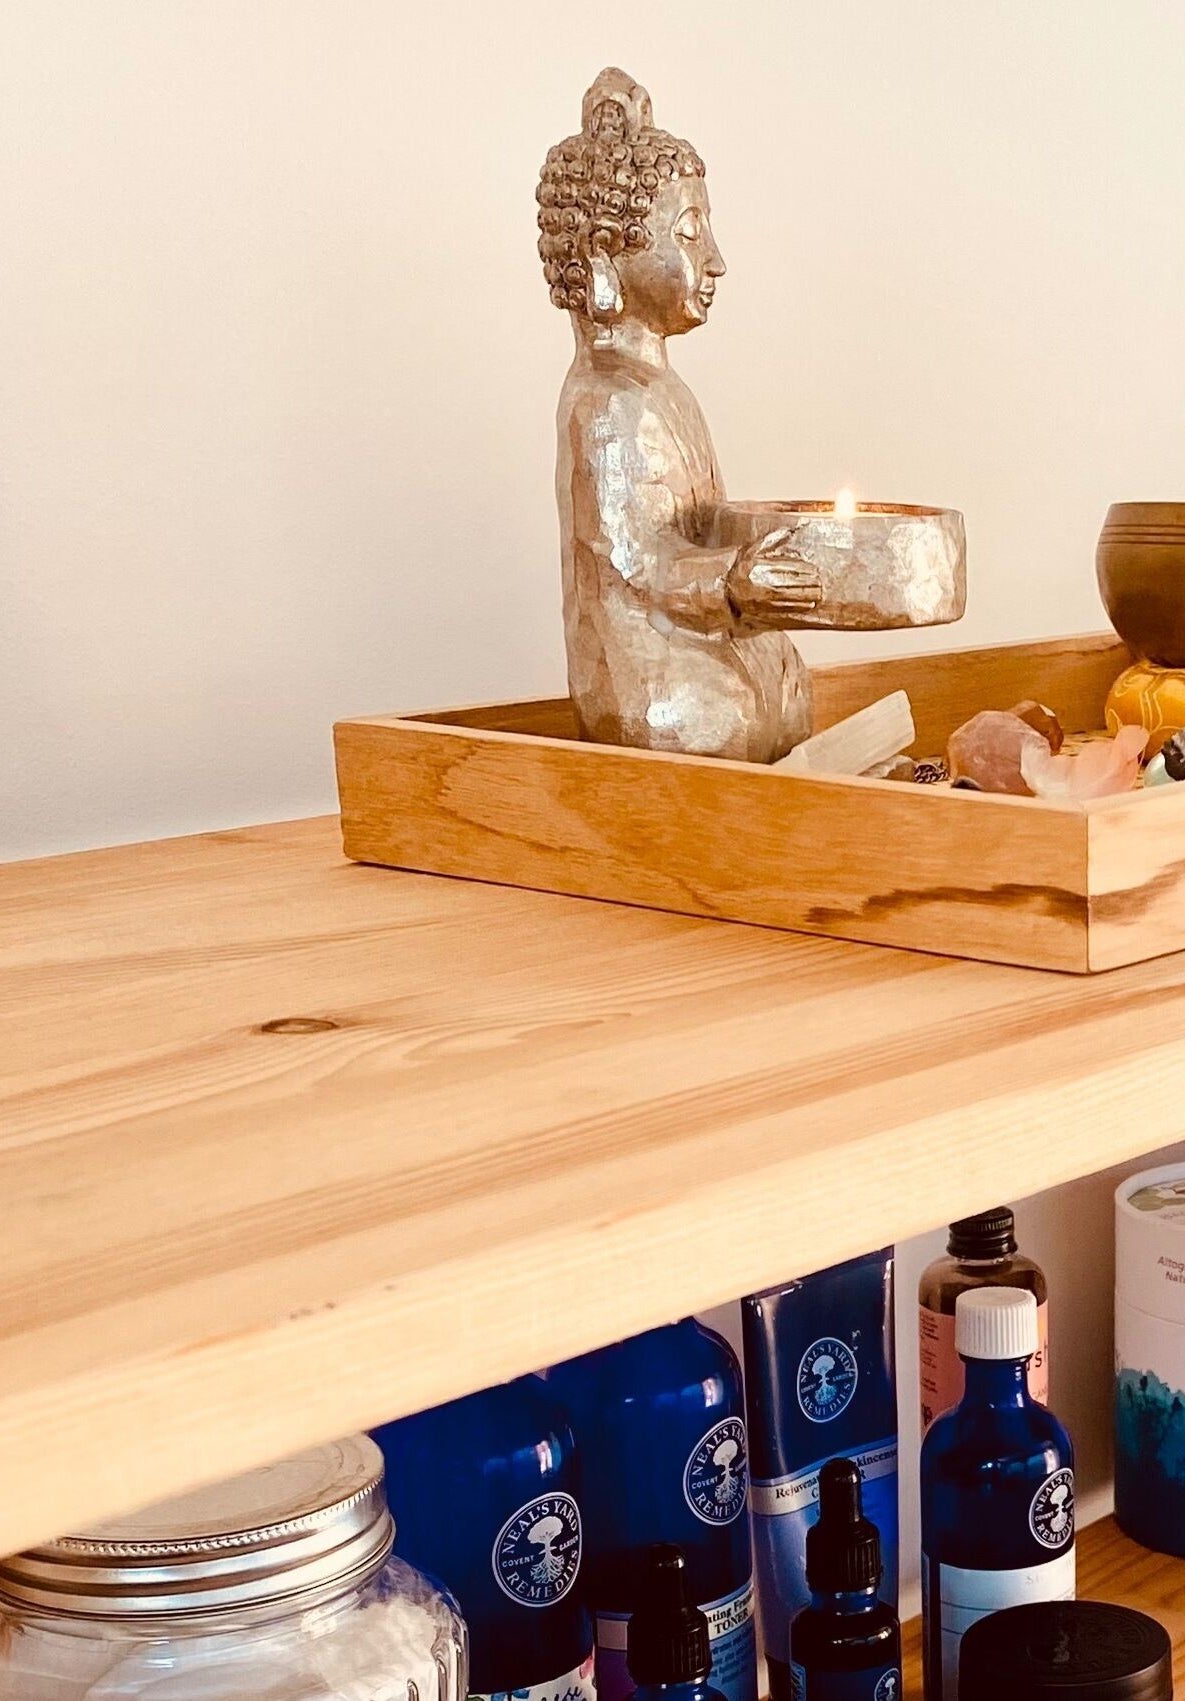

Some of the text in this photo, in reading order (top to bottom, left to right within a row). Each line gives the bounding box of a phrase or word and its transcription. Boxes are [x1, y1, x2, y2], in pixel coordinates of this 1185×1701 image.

[691, 1426, 730, 1476] NEAL'S
[501, 1500, 578, 1554] NEAL'S YARD
[501, 1554, 534, 1568] COVENT
[506, 1550, 578, 1598] REMEDIES
[714, 1607, 749, 1634] TONER
